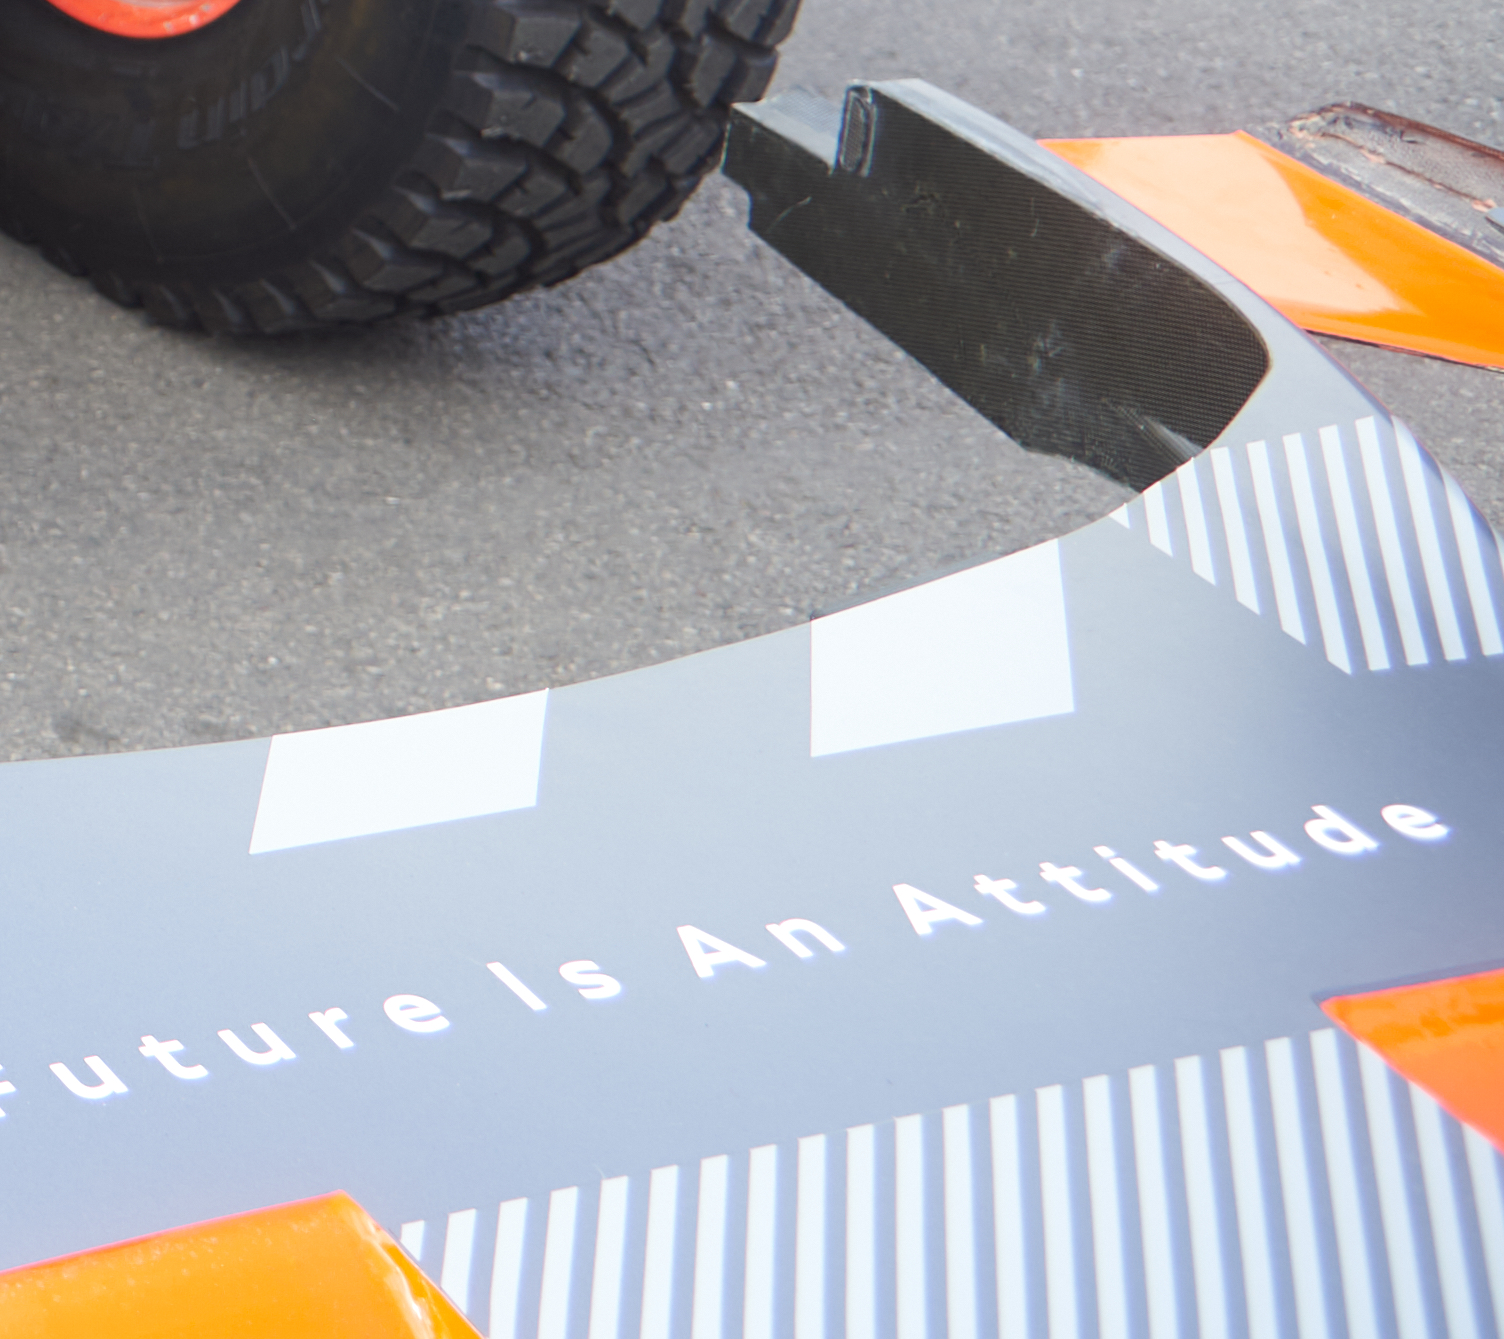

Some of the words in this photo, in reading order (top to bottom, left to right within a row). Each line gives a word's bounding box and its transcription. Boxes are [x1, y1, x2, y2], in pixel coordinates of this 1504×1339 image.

[488, 943, 625, 1014] Is
[677, 911, 846, 982] An
[890, 791, 1452, 938] Attitude
